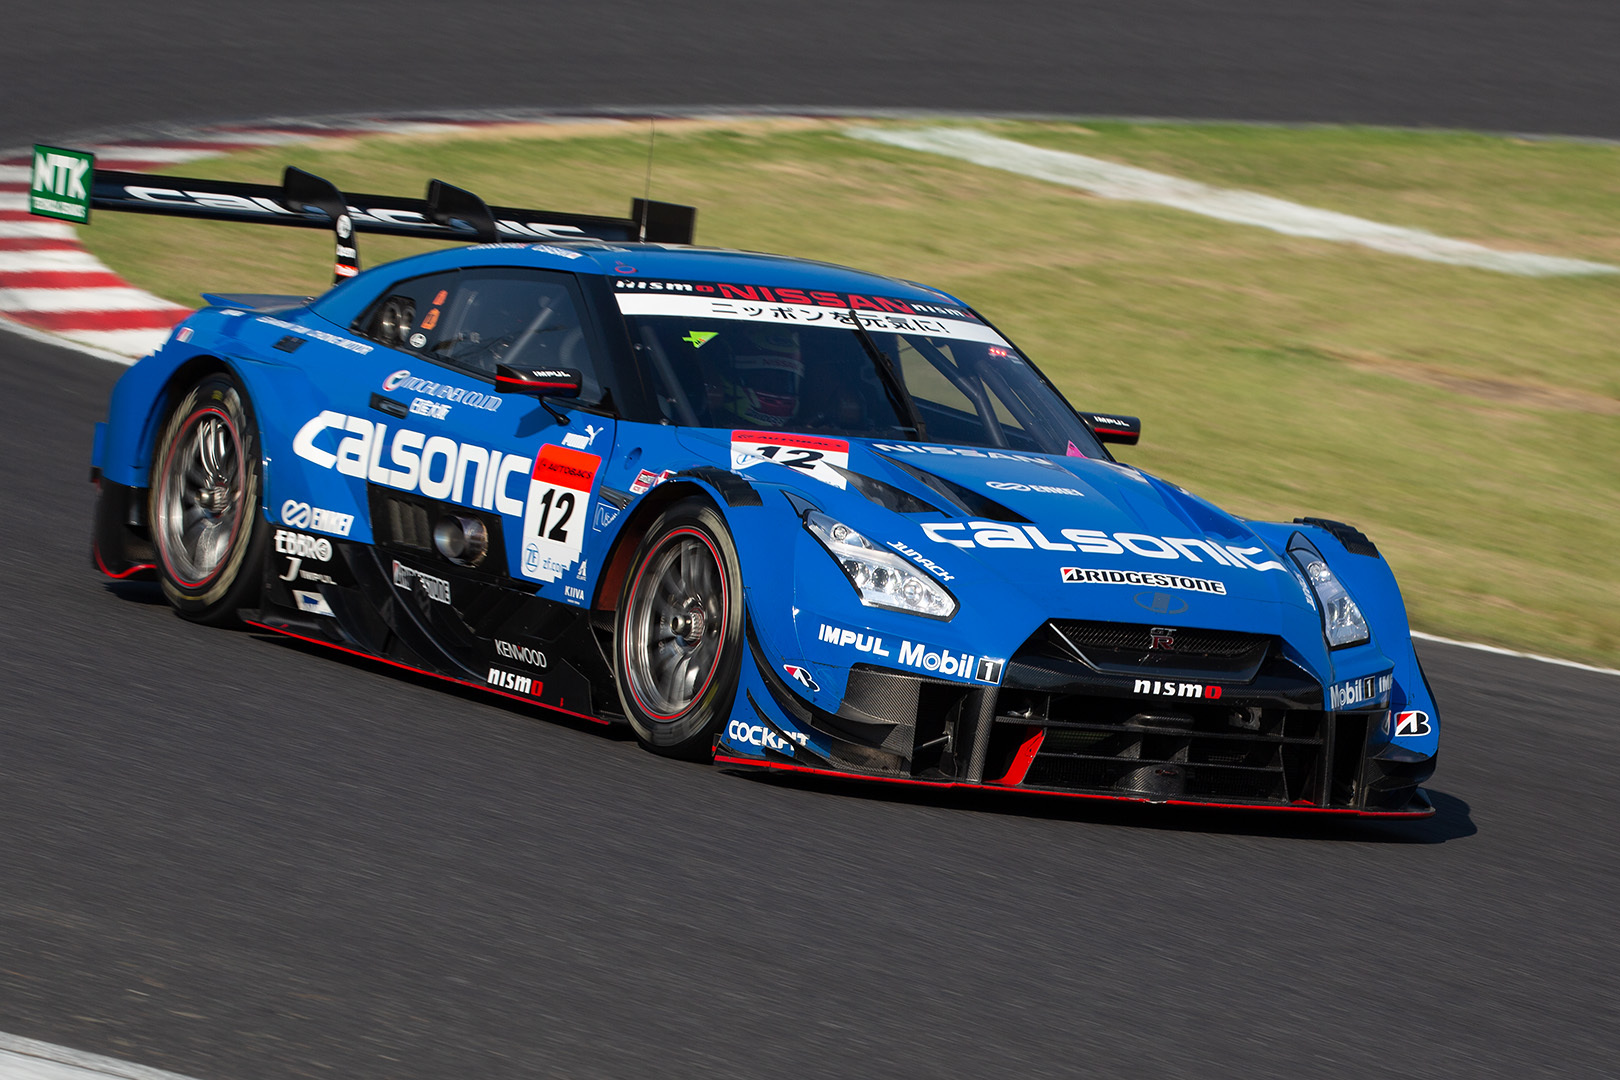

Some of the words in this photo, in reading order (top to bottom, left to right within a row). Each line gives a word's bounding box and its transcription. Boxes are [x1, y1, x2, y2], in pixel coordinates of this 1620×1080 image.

[33, 152, 89, 201] NTK
[717, 283, 917, 315] NISSAN
[532, 370, 571, 378] IMPUL
[1093, 415, 1130, 428] IMPUL
[756, 446, 824, 470] 12
[872, 443, 1053, 466] NISSAN
[548, 462, 593, 480] AUTOBACS
[538, 488, 576, 543] 12
[274, 529, 334, 562] EBBRO
[886, 541, 956, 581] JUNACK
[564, 585, 584, 600] KIIVA
[1063, 568, 1225, 594] BRIDGESTONE
[494, 638, 548, 668] KENWOOD
[818, 623, 890, 657] IMPUL
[898, 640, 975, 679] Mobil
[487, 667, 544, 697] nismo
[1133, 678, 1222, 700] nismo
[1329, 678, 1363, 709] Mobil
